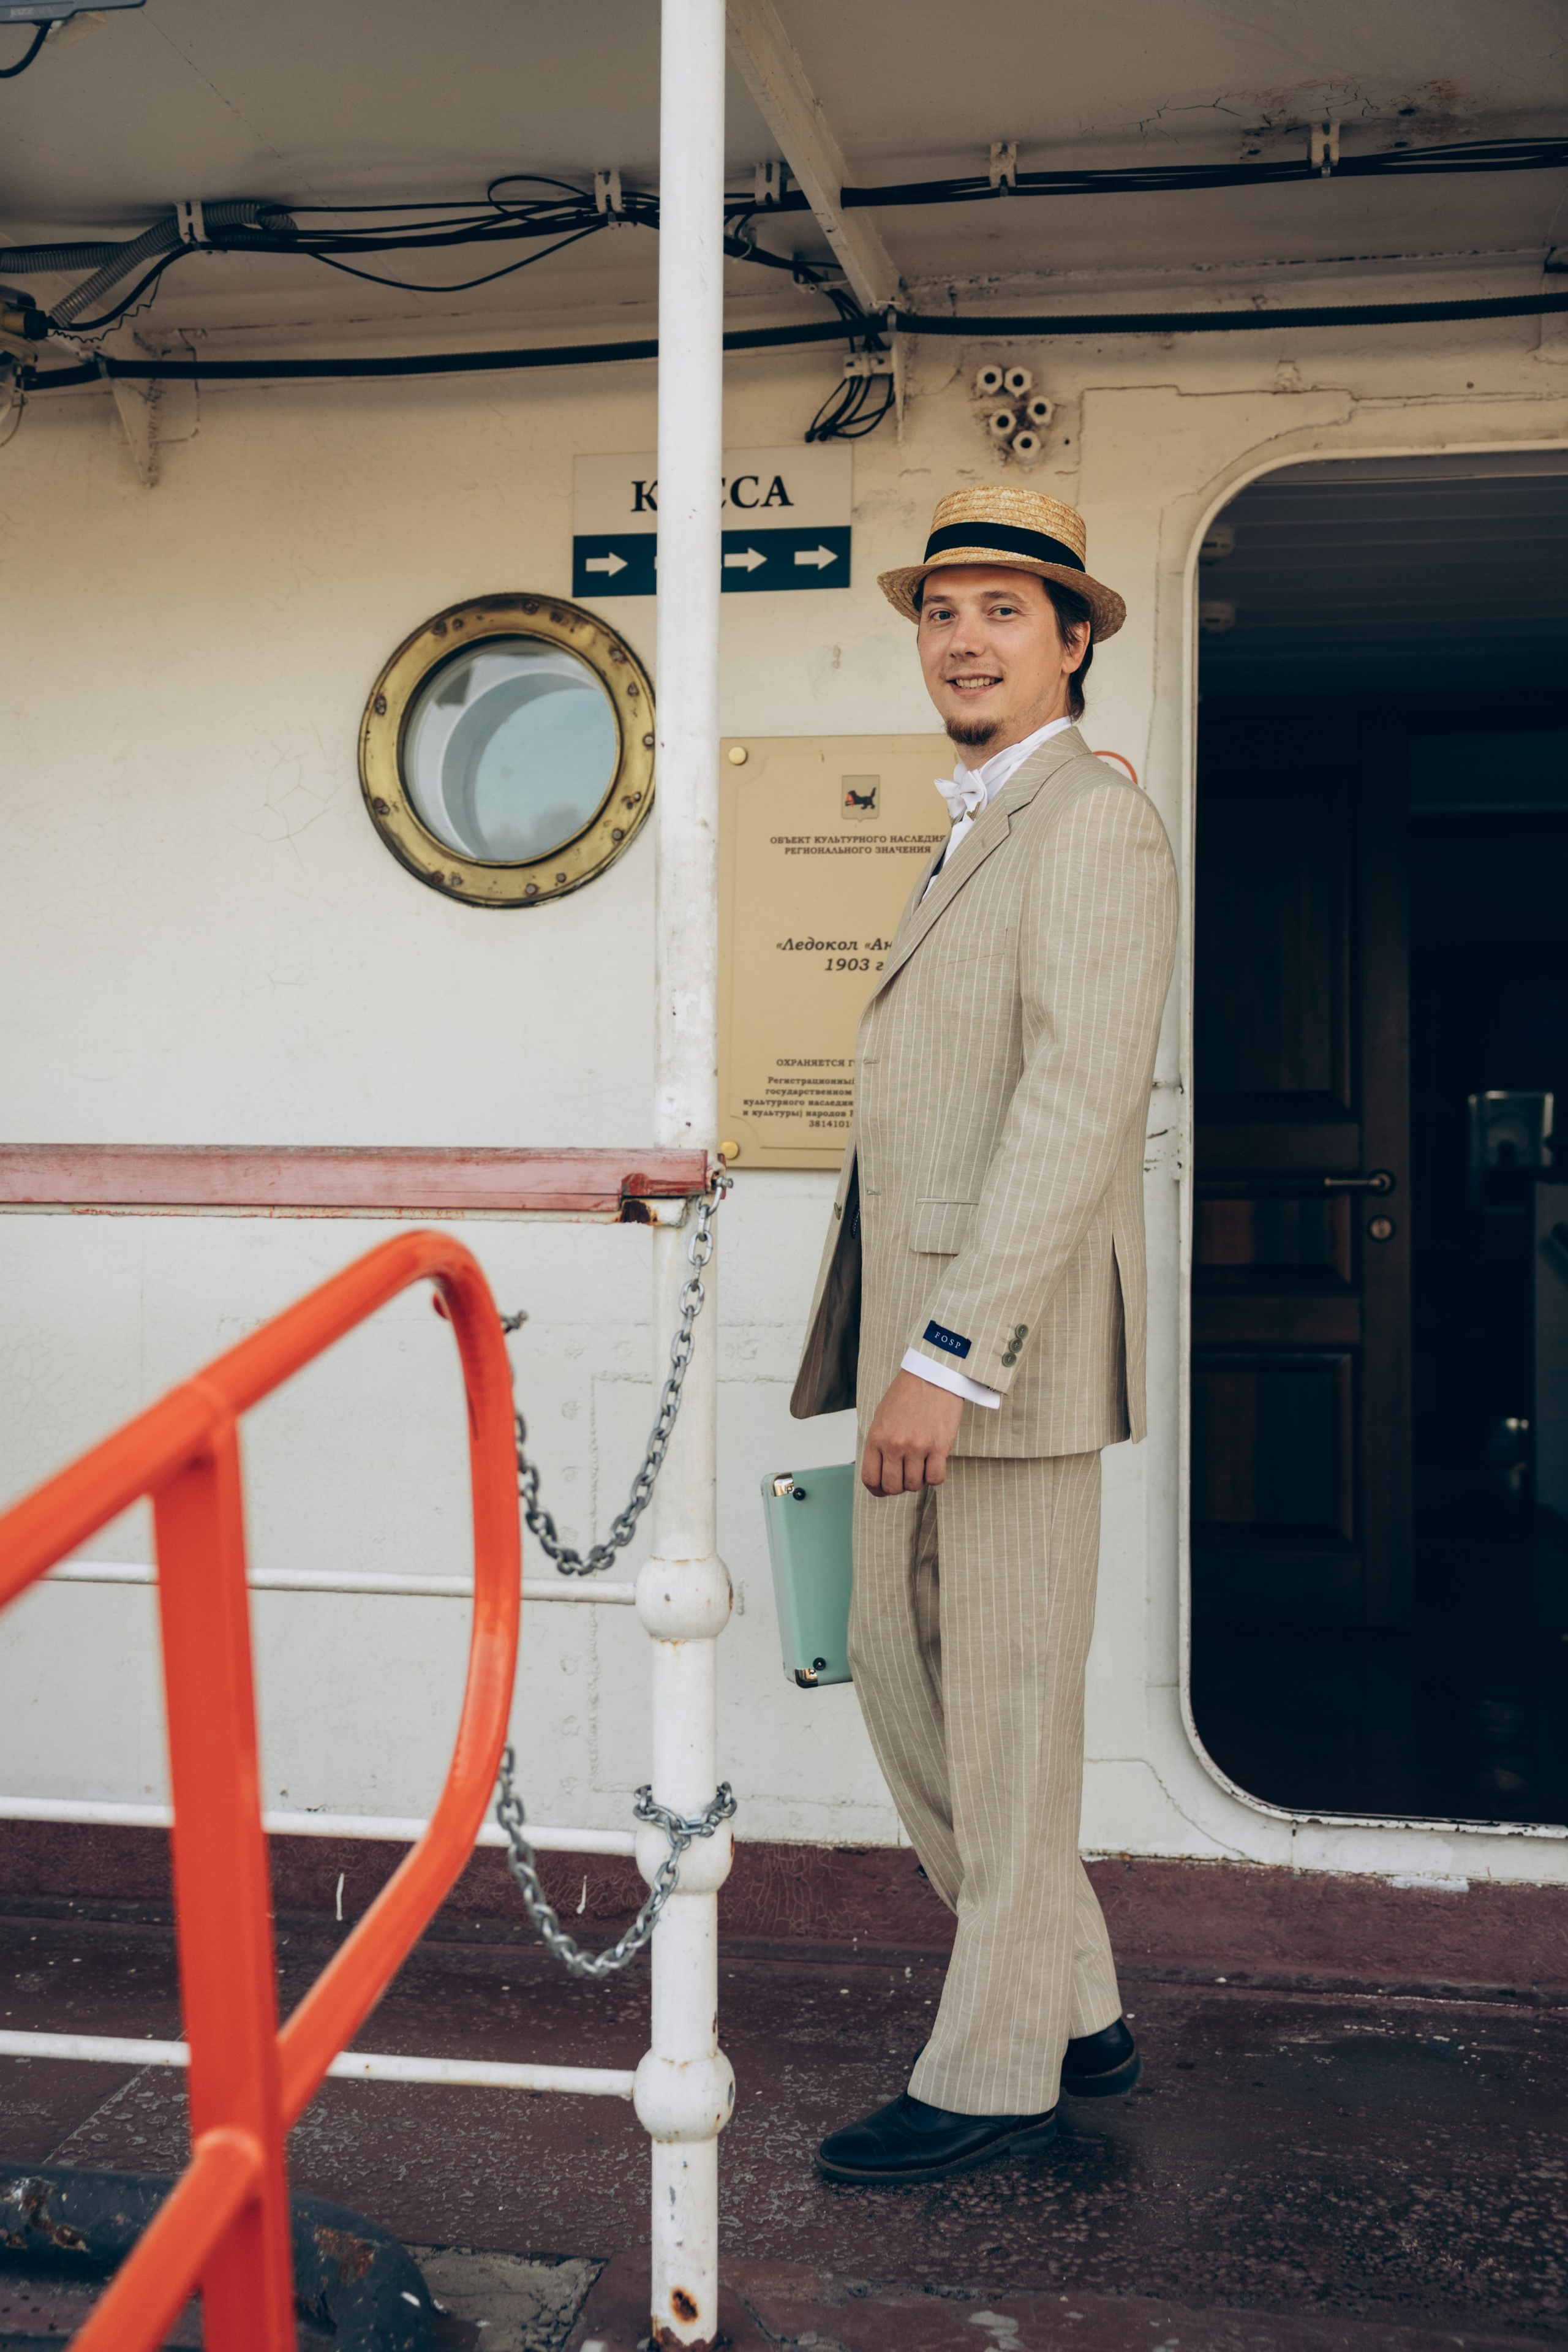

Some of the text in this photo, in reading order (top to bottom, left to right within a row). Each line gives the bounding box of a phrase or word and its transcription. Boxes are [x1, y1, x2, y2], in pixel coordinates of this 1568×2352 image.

[630, 475, 795, 513] КСА
[769, 835, 812, 845] ОБЪЕКТ
[813, 835, 888, 844] КУЛЬТУРНОГО
[785, 845, 932, 855] РЕГИОНАЛЬНОГО ЗНАЧЕНИЯ
[776, 936, 858, 951] «Ледокол
[824, 957, 870, 971] 1903
[776, 1058, 845, 1067] ОХРАНЯЕТСЯ
[765, 1089, 852, 1098] государственном
[743, 1099, 805, 1107] культурного
[752, 1109, 803, 1118] культуры)
[809, 1120, 851, 1128] 3814101
[934, 1331, 961, 1349] FOSP
